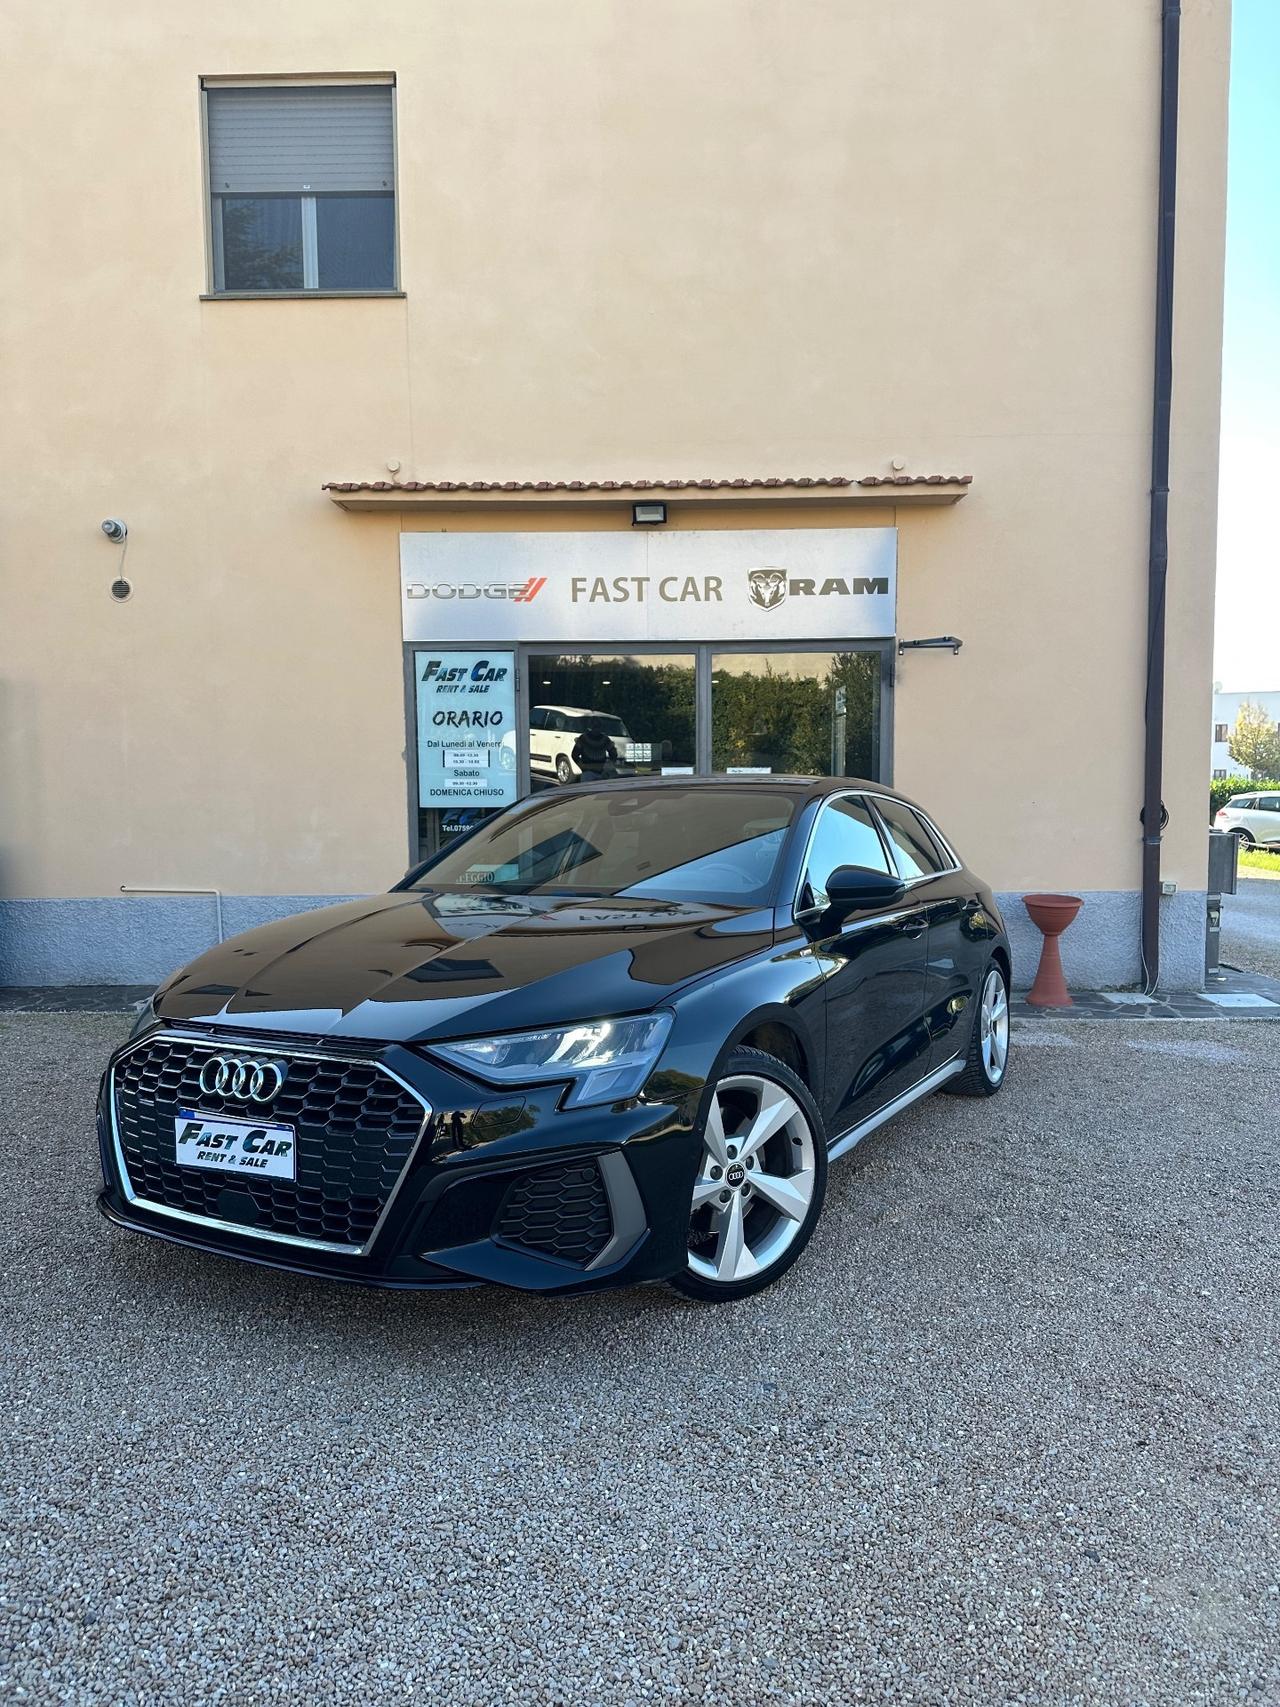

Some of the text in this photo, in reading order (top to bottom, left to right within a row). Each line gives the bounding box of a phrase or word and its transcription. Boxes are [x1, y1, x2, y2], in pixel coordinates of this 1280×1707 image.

[406, 582, 530, 600] DODGE
[570, 575, 723, 603] FAST CAR
[788, 577, 889, 596] RAM
[471, 660, 508, 681] CAR
[436, 685, 459, 693] RENT
[468, 685, 490, 693] SALE
[432, 710, 503, 728] ORARIO
[427, 740, 440, 748] Dal
[453, 769, 480, 777] Sabato
[430, 788, 504, 797] DOMENICA CHIUSO
[178, 1122, 292, 1157] FAST CAR
[197, 1150, 269, 1168] RENT & SALE
